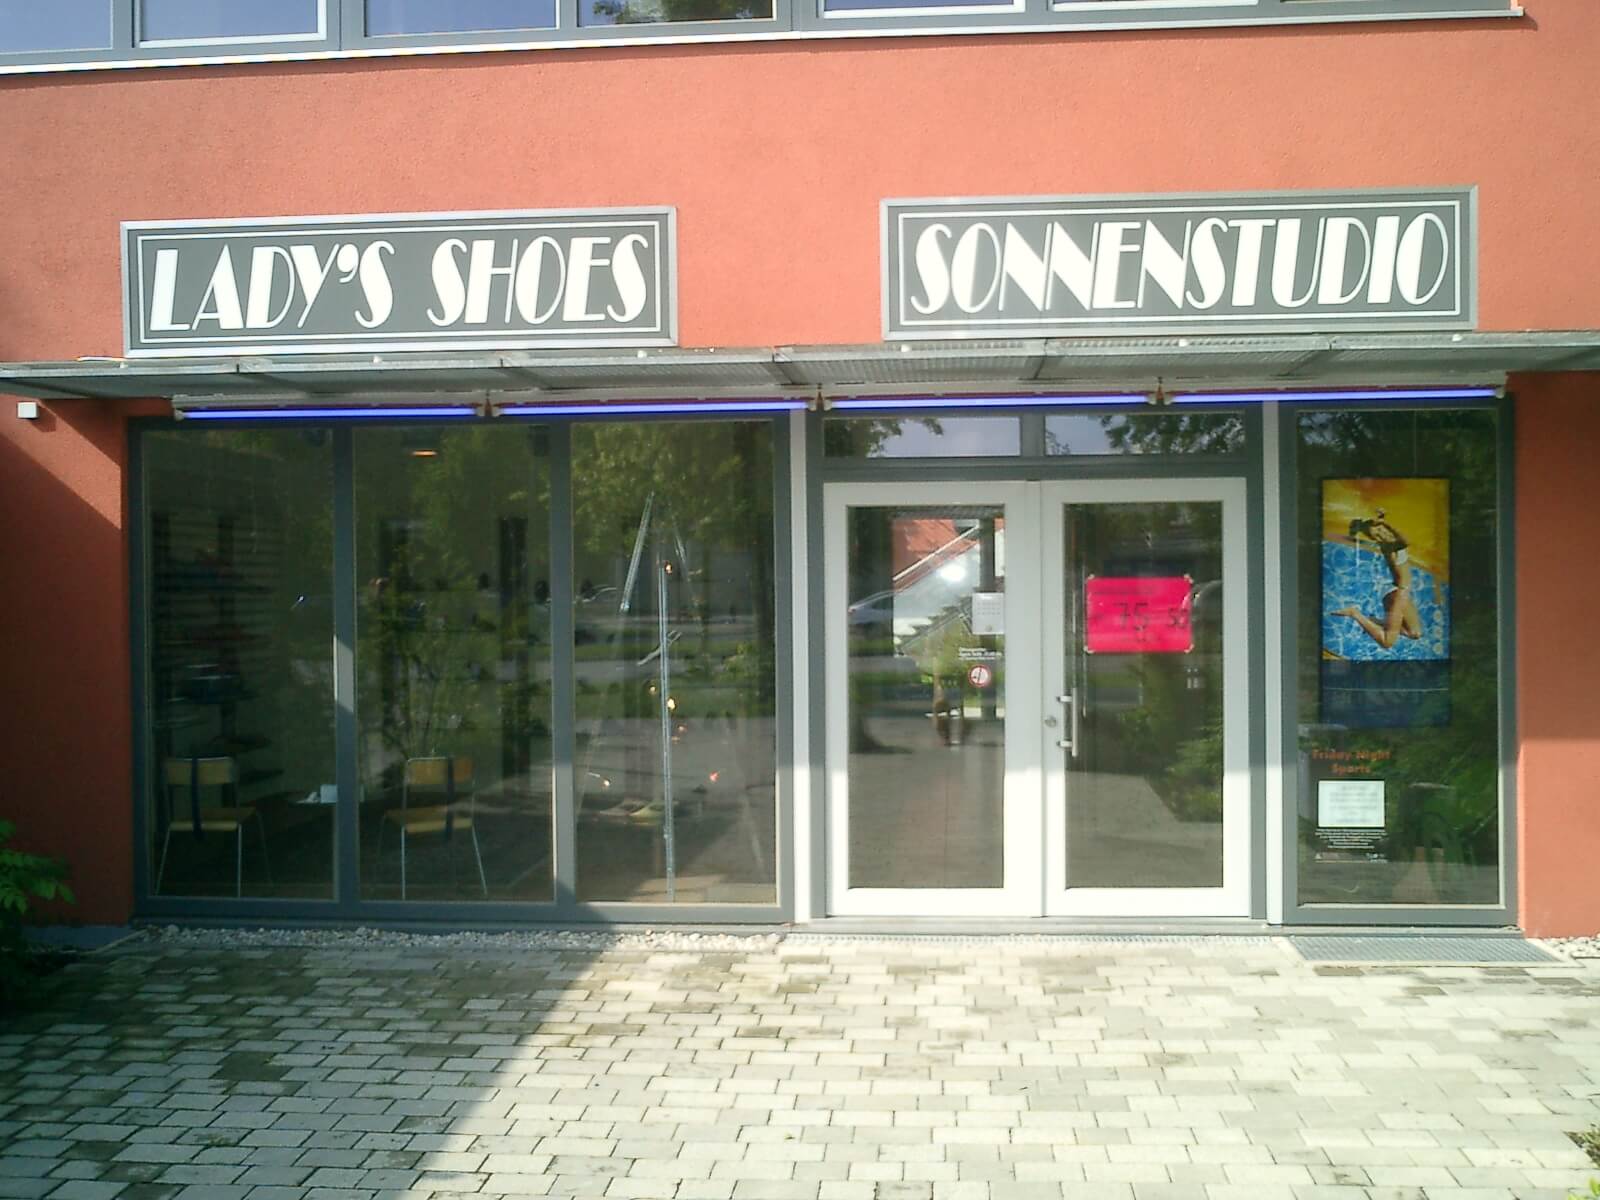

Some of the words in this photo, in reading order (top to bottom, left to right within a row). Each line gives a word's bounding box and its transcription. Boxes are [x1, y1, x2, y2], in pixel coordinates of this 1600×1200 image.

[149, 240, 395, 331] LADY'S
[427, 233, 649, 327] SHOES
[910, 212, 1449, 314] SONNENSTUDIO
